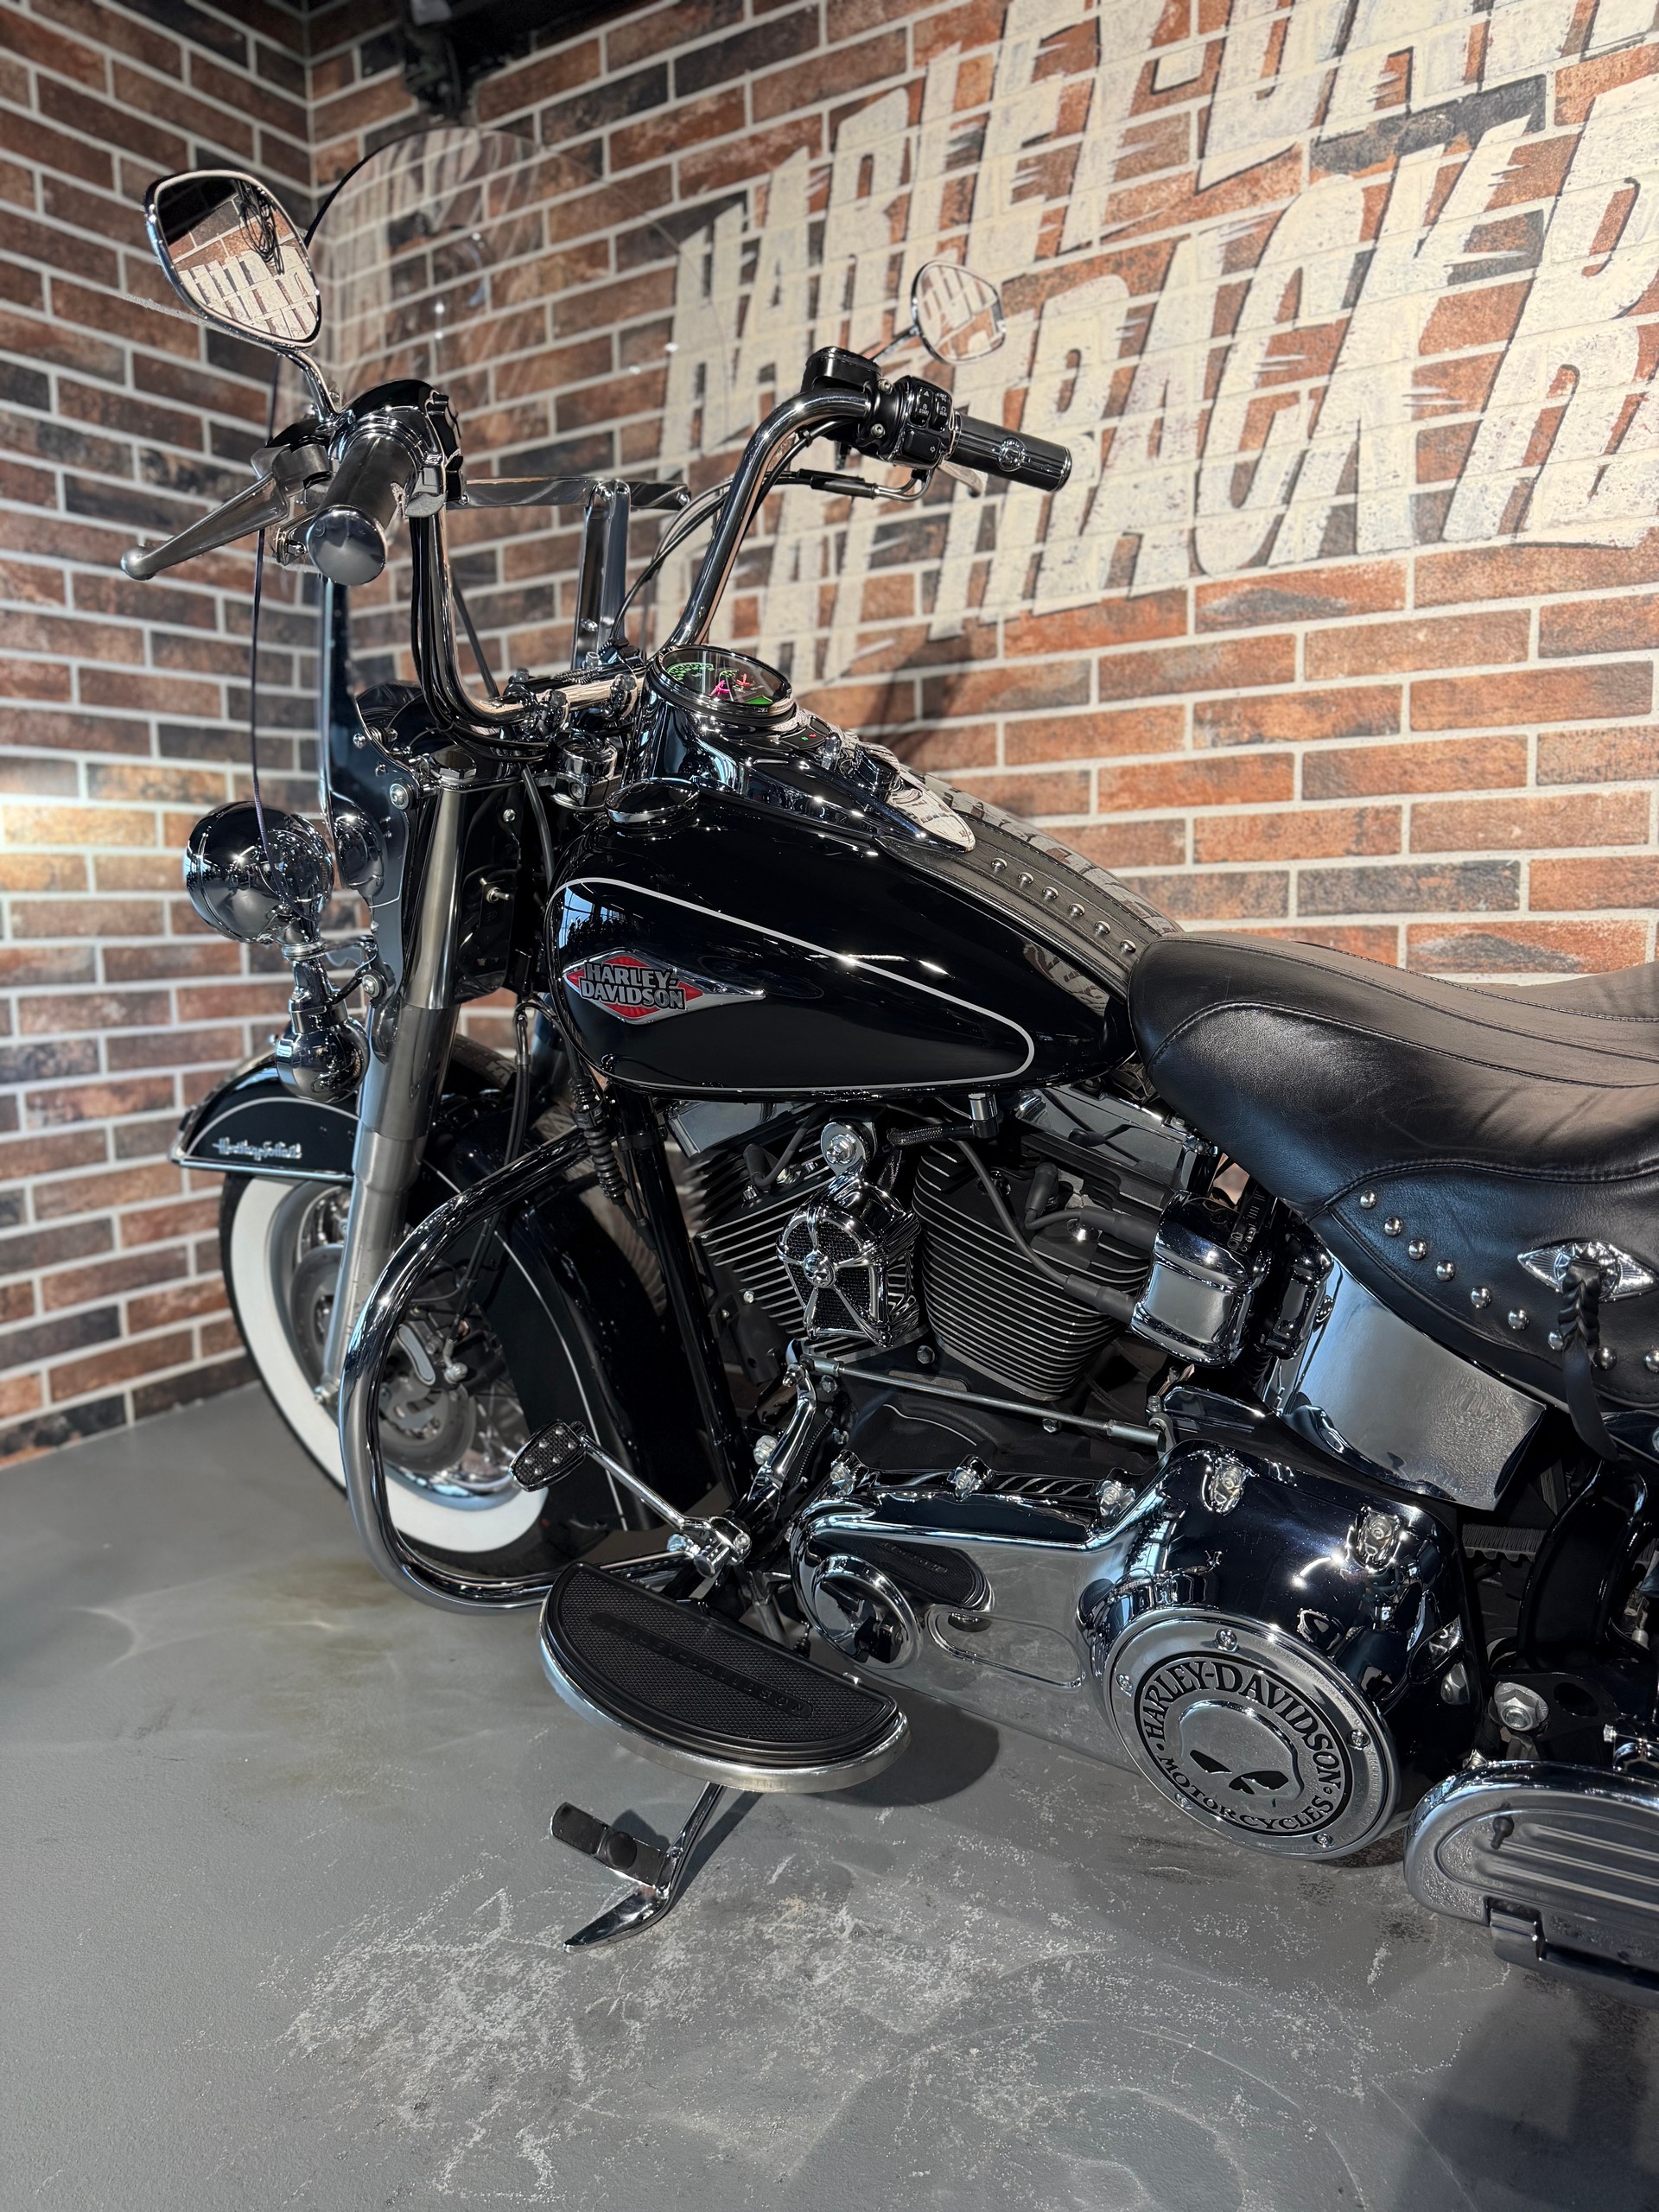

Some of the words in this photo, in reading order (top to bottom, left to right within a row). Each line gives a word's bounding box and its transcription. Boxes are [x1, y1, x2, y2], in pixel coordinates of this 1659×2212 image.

[1441, 67, 1659, 550] R
[579, 979, 686, 1010] DAVIDSON
[585, 963, 679, 990] HARLEY-
[1141, 1660, 1342, 1789] HARLEY-DAVIDSON
[1160, 1757, 1335, 1831] MOTORCYCLES
